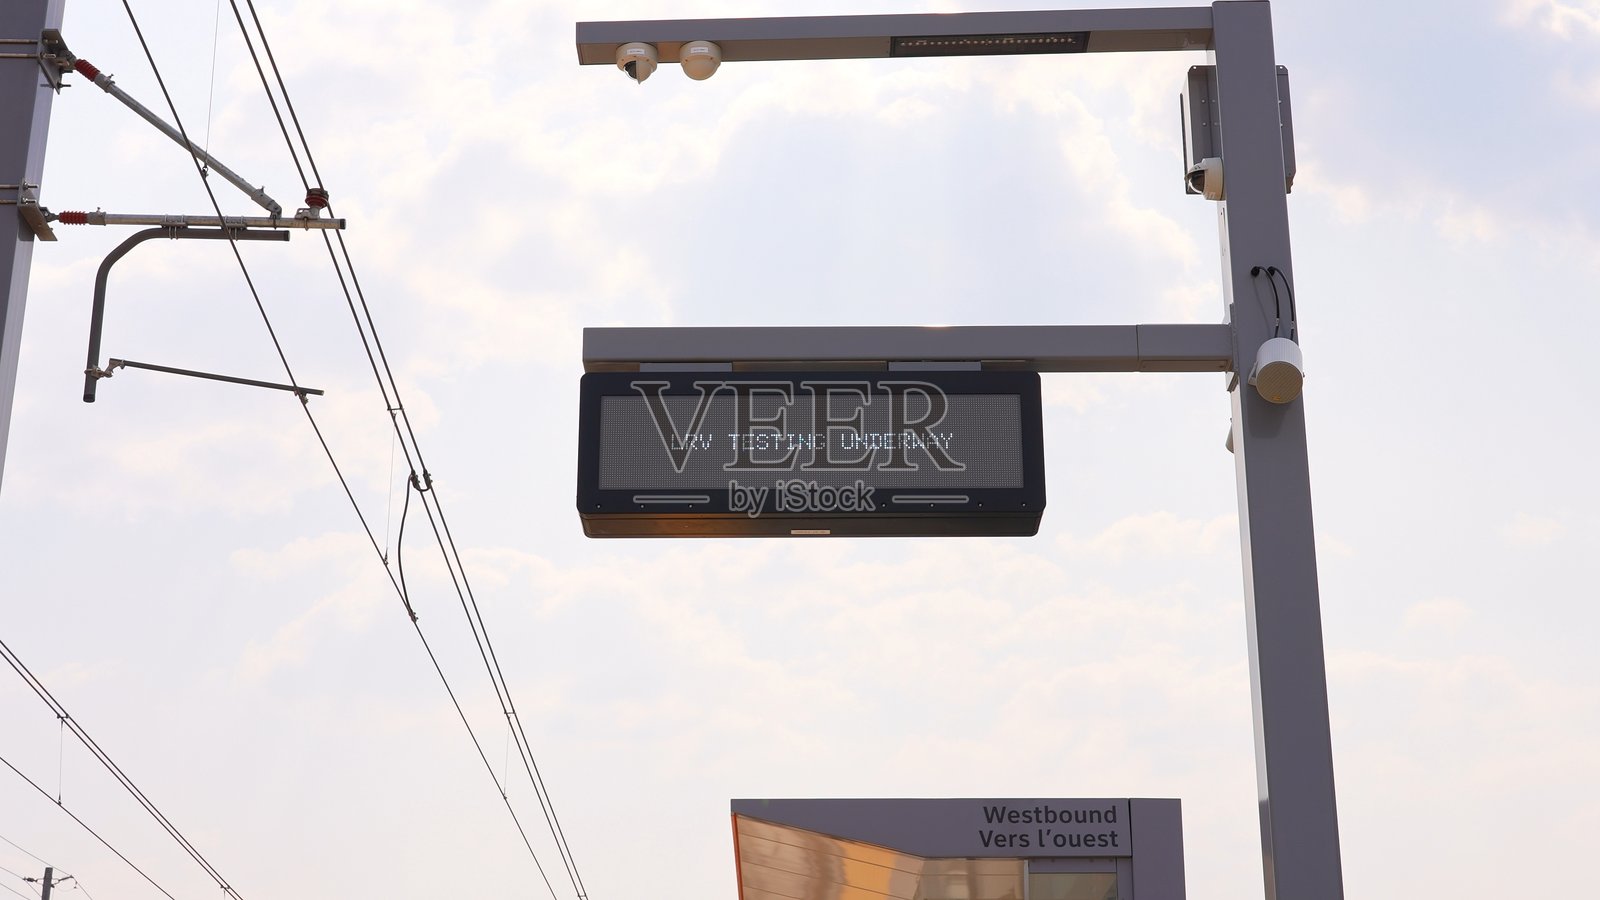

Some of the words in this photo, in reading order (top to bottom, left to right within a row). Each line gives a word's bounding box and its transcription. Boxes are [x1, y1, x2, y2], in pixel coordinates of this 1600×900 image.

[671, 433, 712, 450] LRV
[728, 433, 826, 450] TESTING
[841, 433, 953, 450] UNDERWAY
[983, 806, 1117, 824] Westbound
[979, 830, 1030, 848] Vers
[1038, 829, 1118, 848] l'ouest
